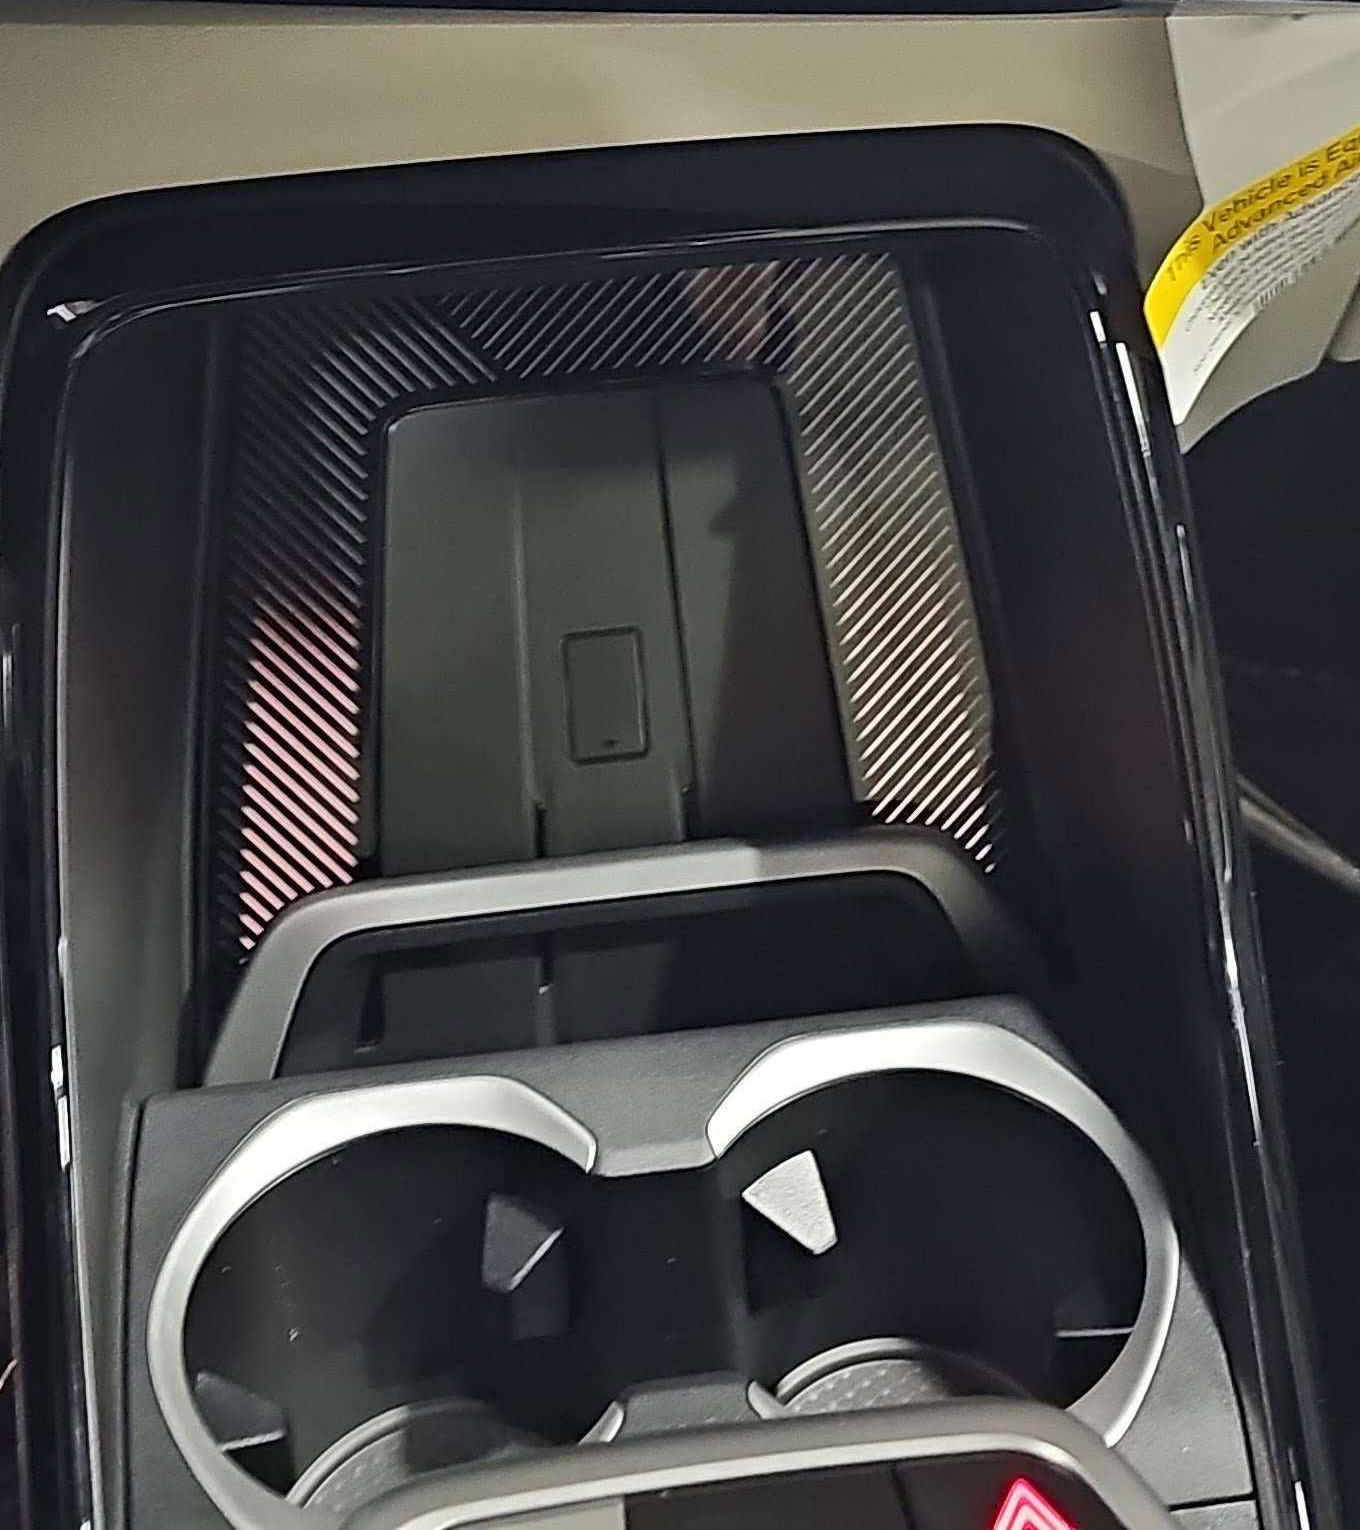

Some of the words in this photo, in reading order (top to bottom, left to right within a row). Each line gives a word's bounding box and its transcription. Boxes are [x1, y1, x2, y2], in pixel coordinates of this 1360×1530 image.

[1202, 172, 1292, 233] Vehicle
[1297, 158, 1320, 178] is
[1209, 171, 1328, 254] Advanced
